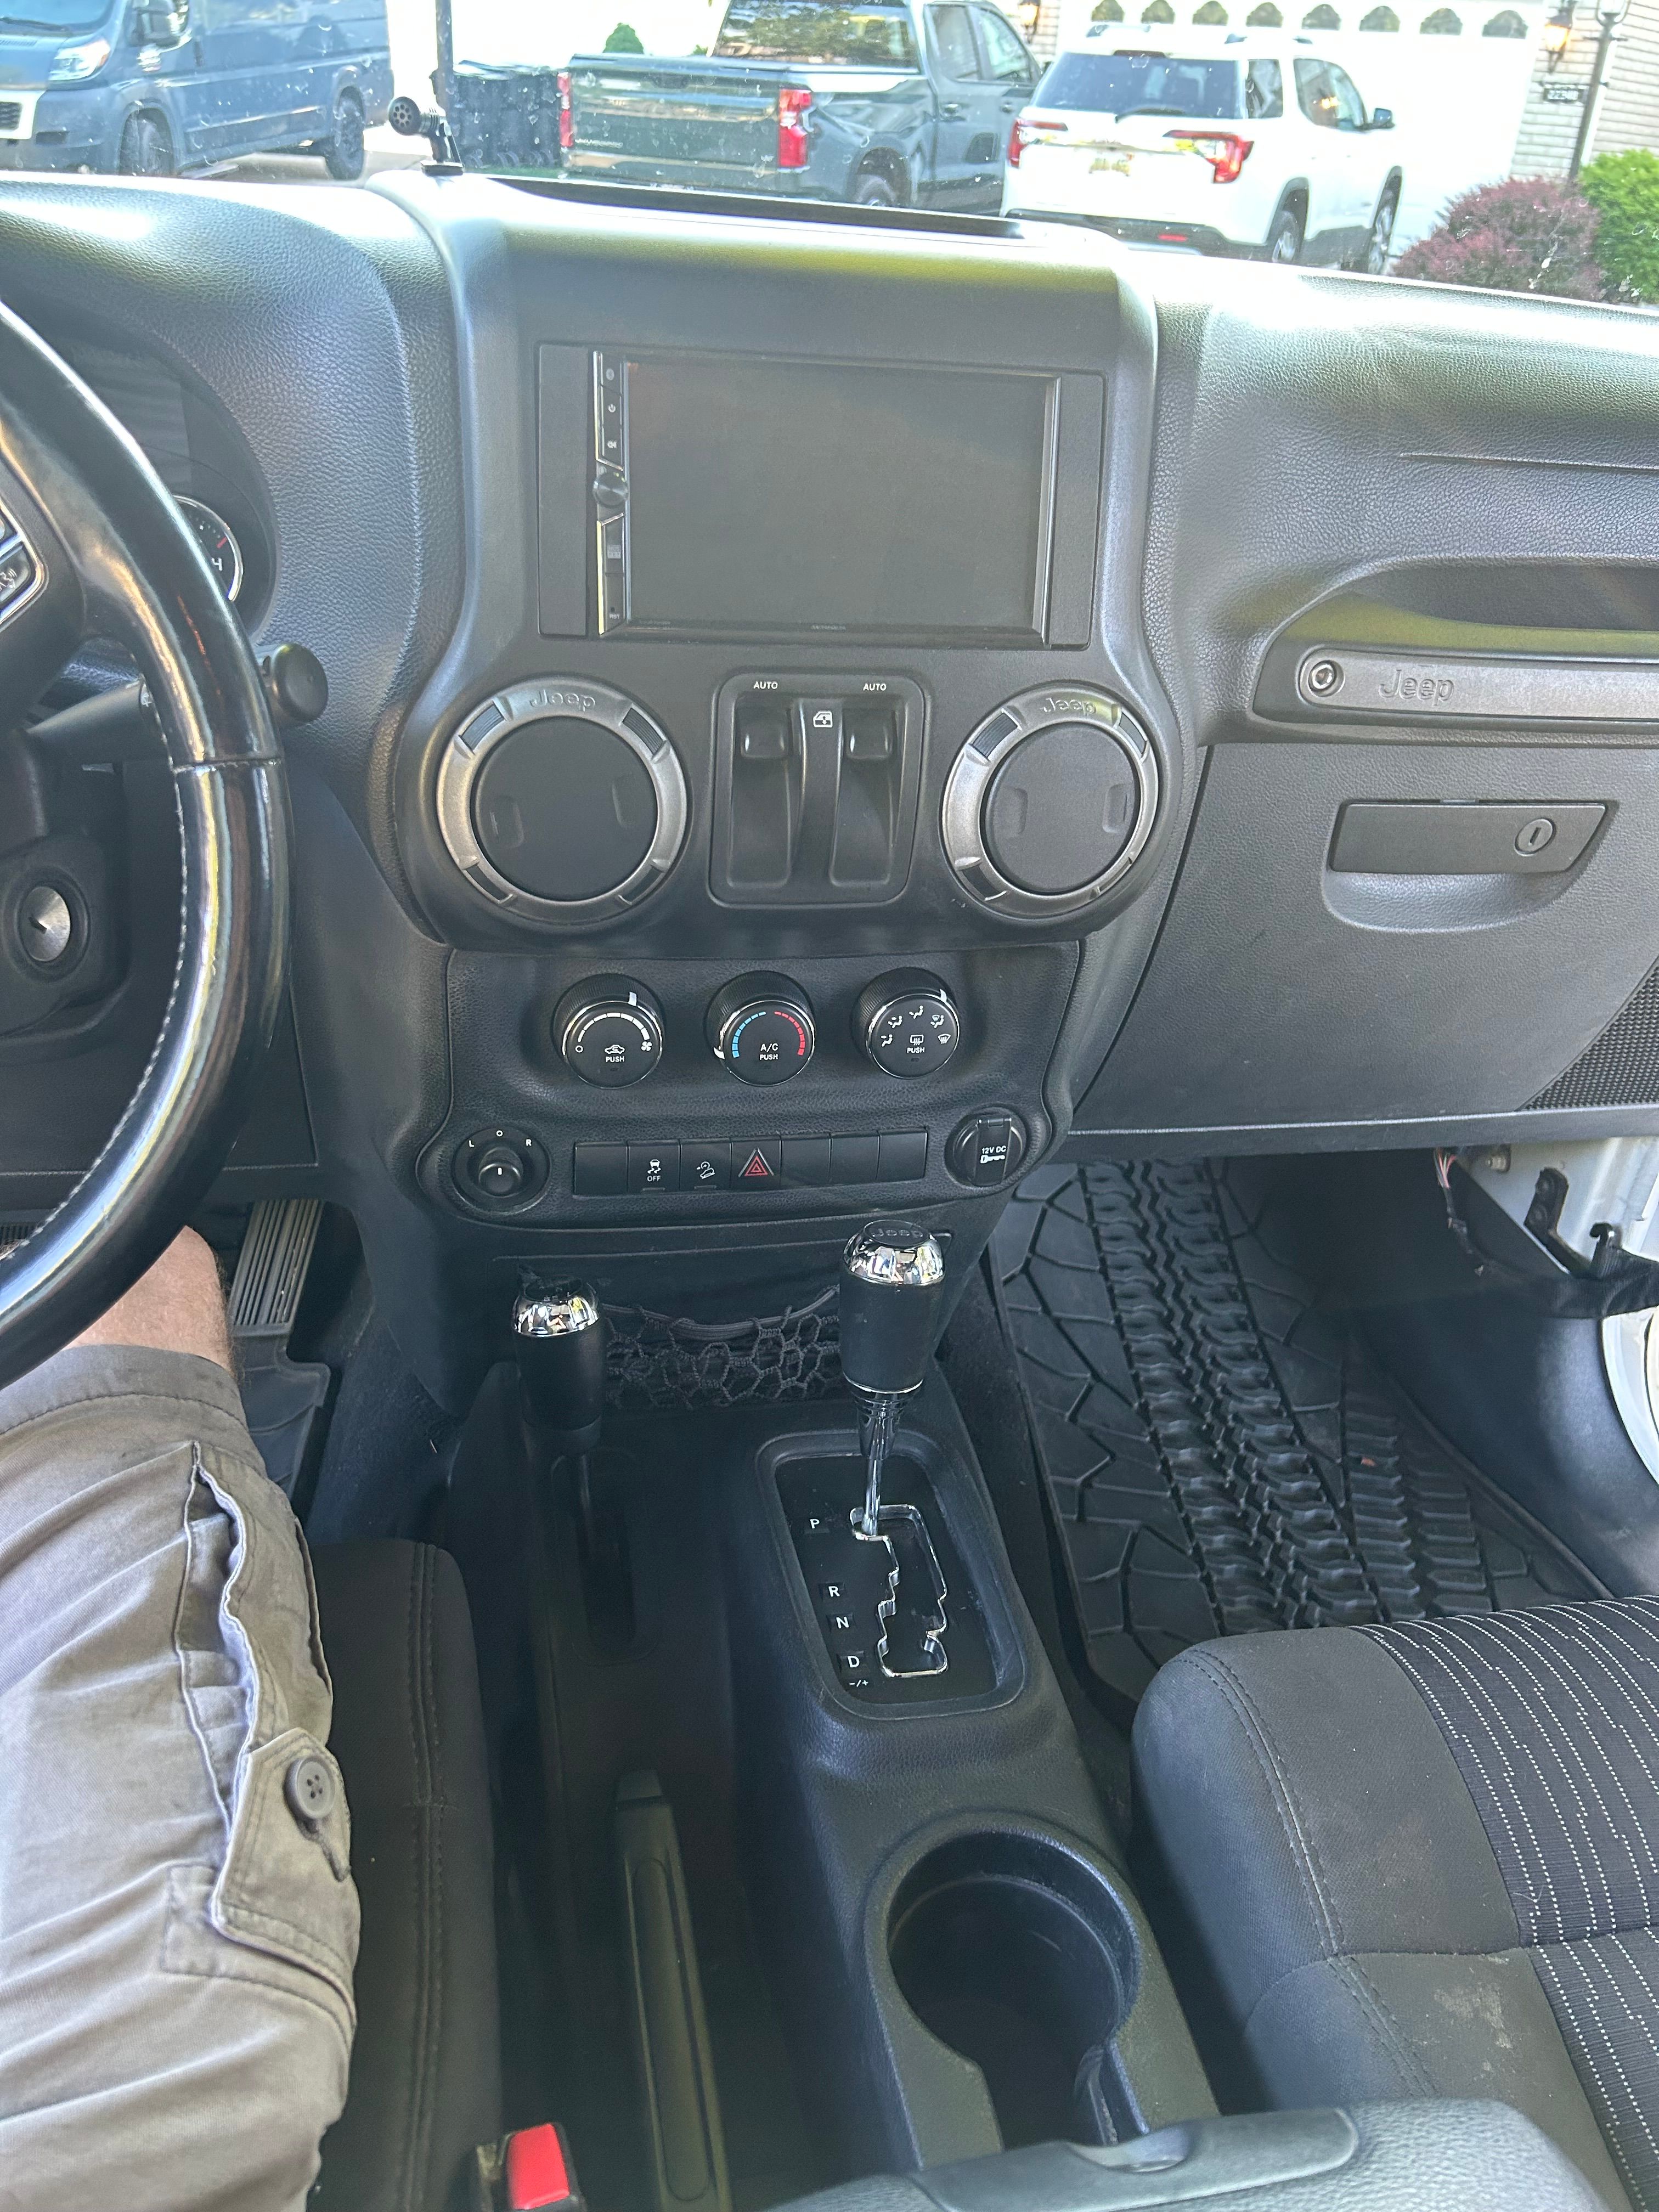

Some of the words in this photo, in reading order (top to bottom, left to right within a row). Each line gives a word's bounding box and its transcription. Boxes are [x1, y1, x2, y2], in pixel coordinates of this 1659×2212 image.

[753, 681, 778, 690] AUTO
[862, 683, 887, 691] AUTO
[1378, 669, 1454, 706] Jeep
[530, 689, 596, 712] Jeep
[1040, 697, 1097, 716] Jeep
[760, 1043, 778, 1053] A/C
[996, 1145, 1007, 1153] DC
[871, 1228, 923, 1238] Jeep
[810, 1519, 820, 1530] P
[828, 1585, 840, 1598] R
[836, 1616, 850, 1629] N
[847, 1655, 860, 1668] D
